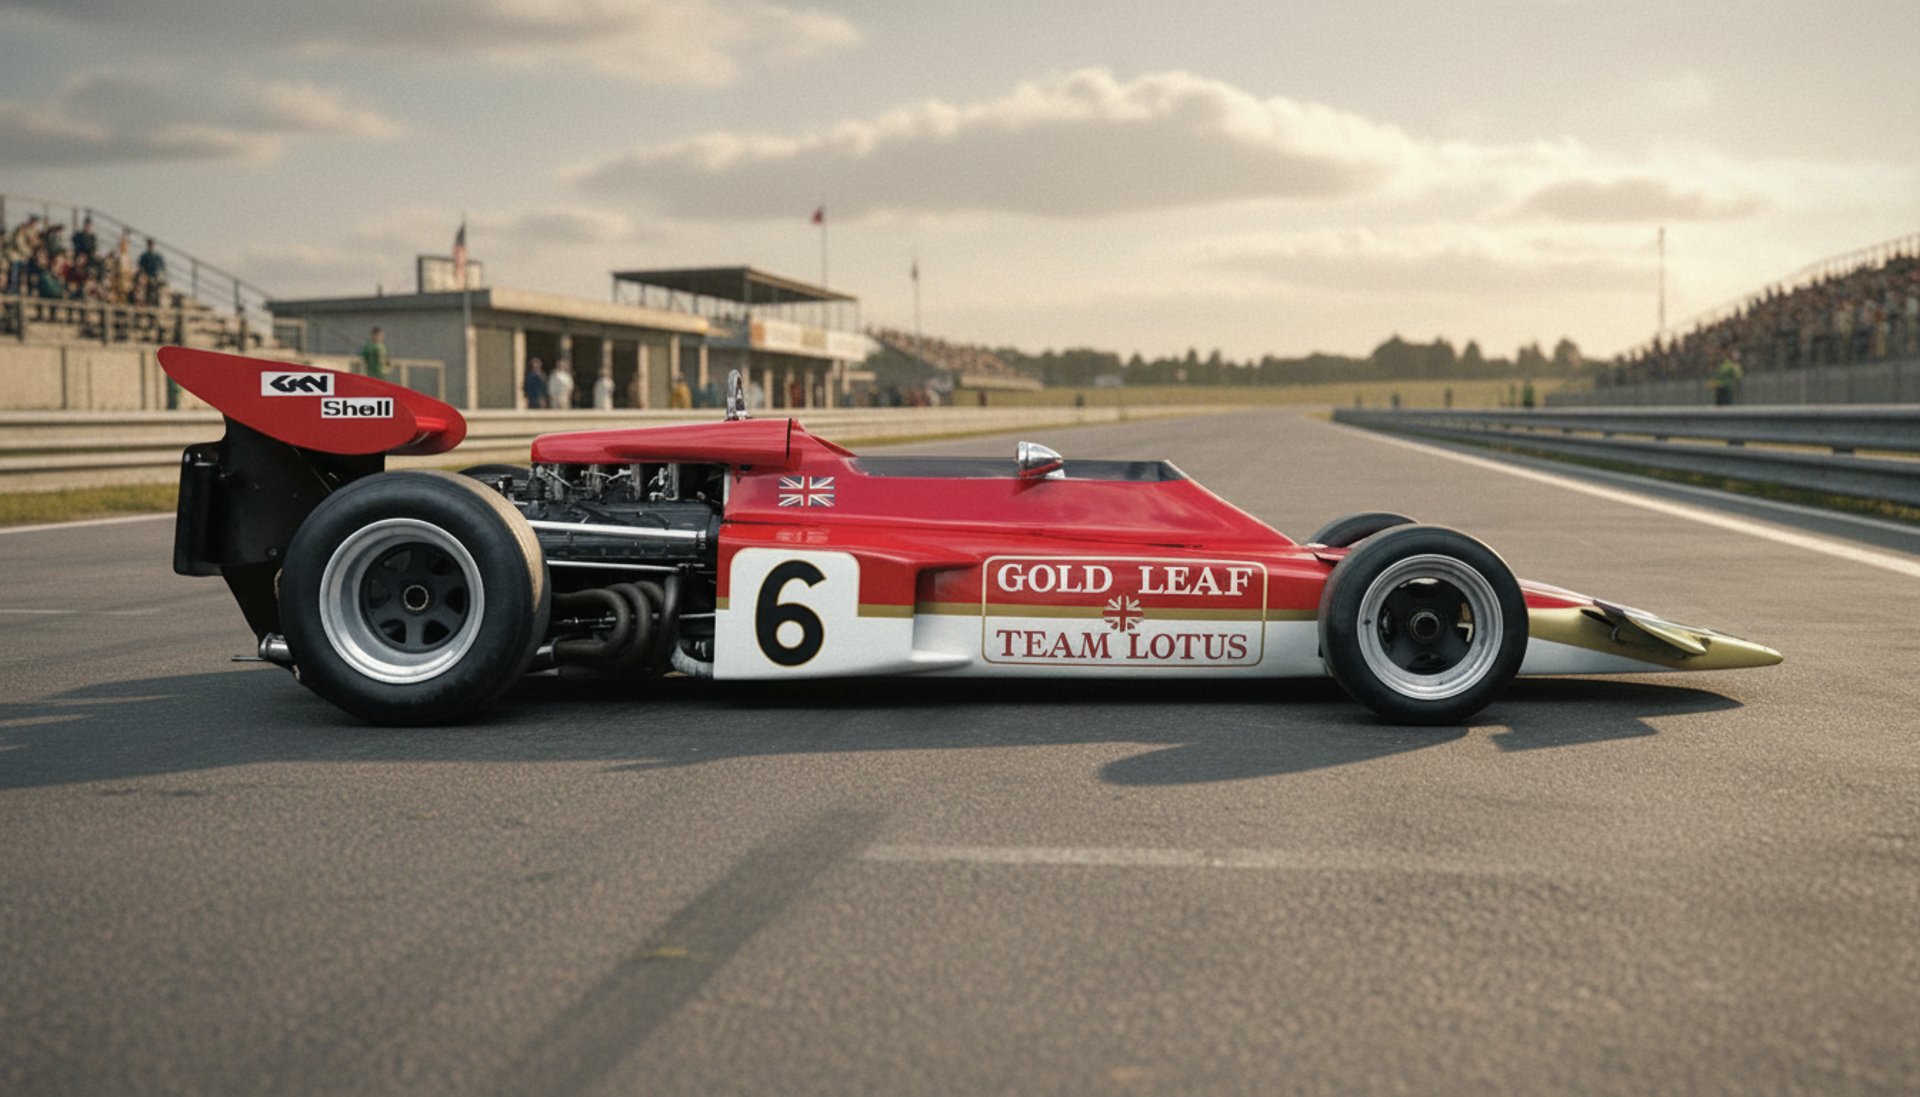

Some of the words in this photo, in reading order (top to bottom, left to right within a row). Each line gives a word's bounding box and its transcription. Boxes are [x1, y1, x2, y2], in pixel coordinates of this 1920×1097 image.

[997, 563, 1113, 594] GOLD
[1137, 565, 1253, 596] LEAF
[755, 558, 826, 667] 6
[996, 629, 1112, 659] TEAM
[1126, 633, 1248, 660] LOTUS
